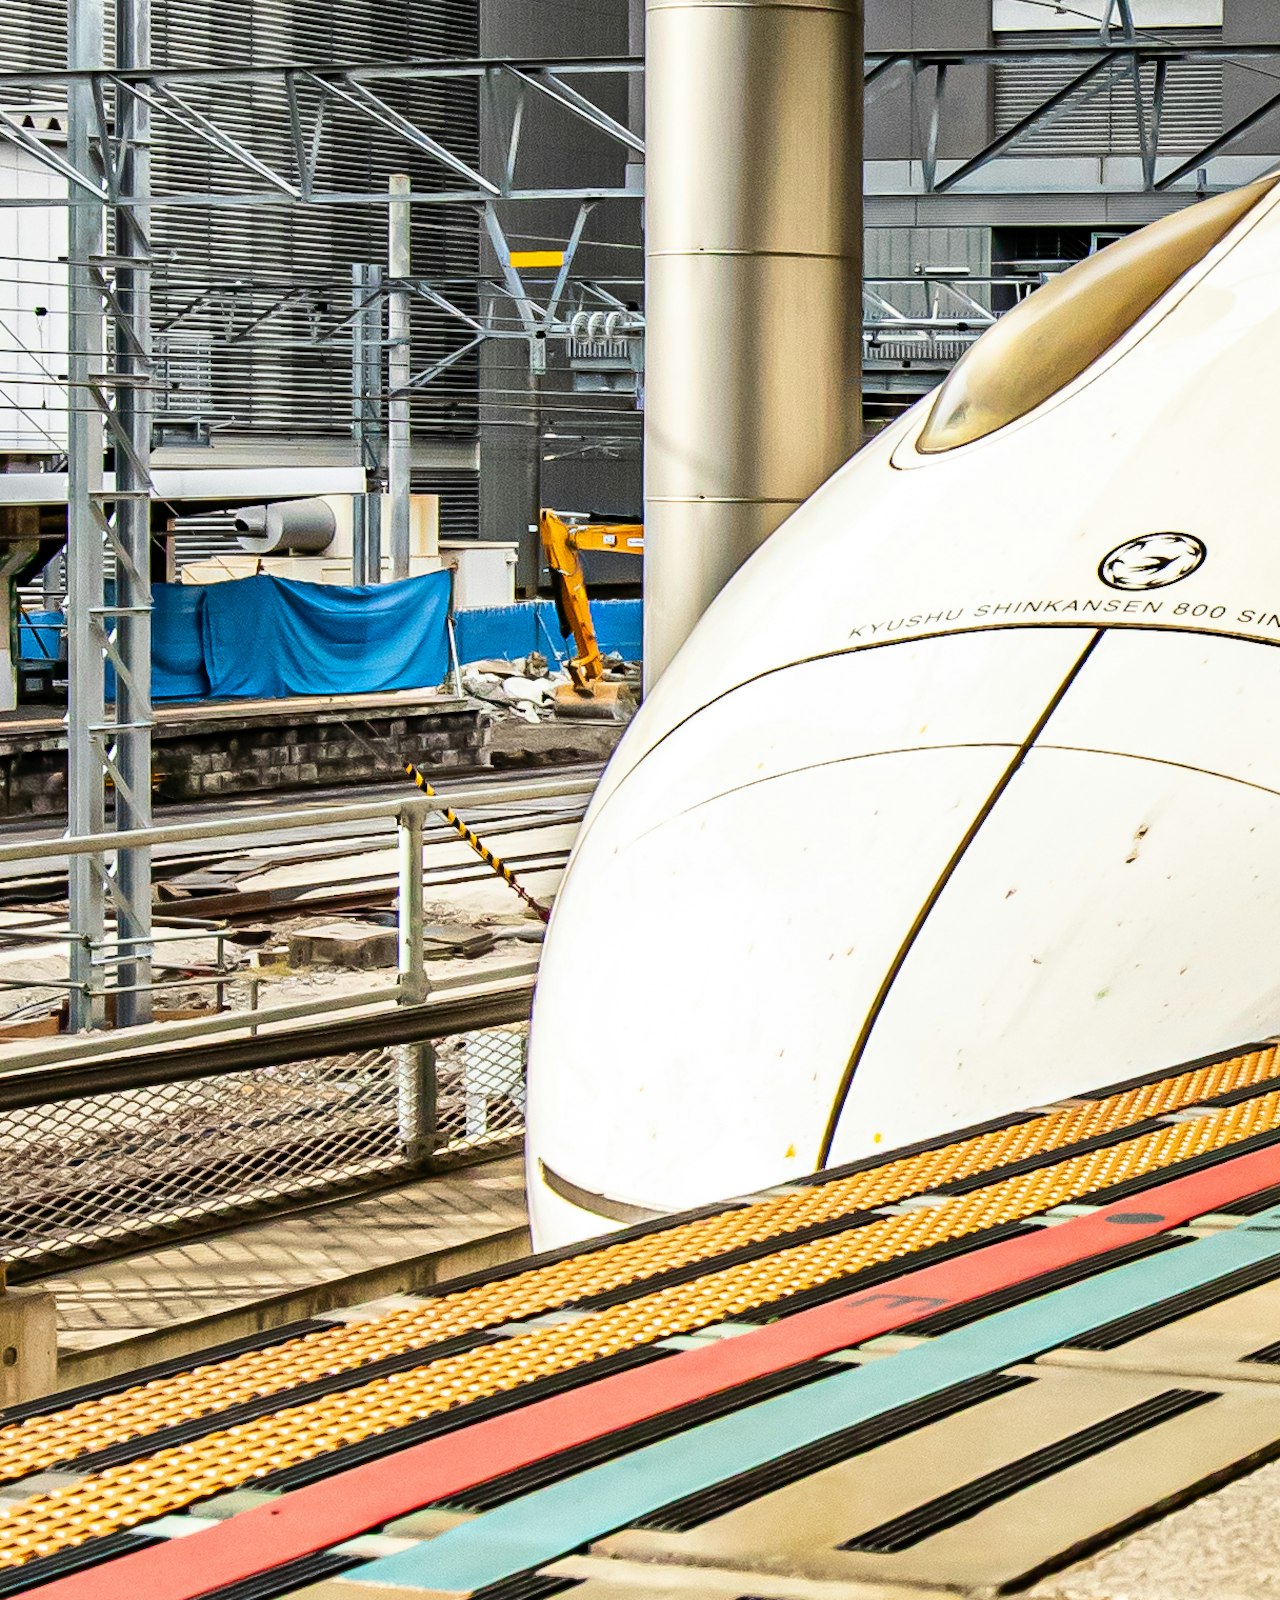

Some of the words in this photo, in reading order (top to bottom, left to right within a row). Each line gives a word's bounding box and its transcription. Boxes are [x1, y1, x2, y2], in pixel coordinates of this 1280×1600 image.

[848, 608, 964, 639] KYUSHU
[973, 599, 1164, 618] SHINKANSEN
[1172, 602, 1228, 619] 800
